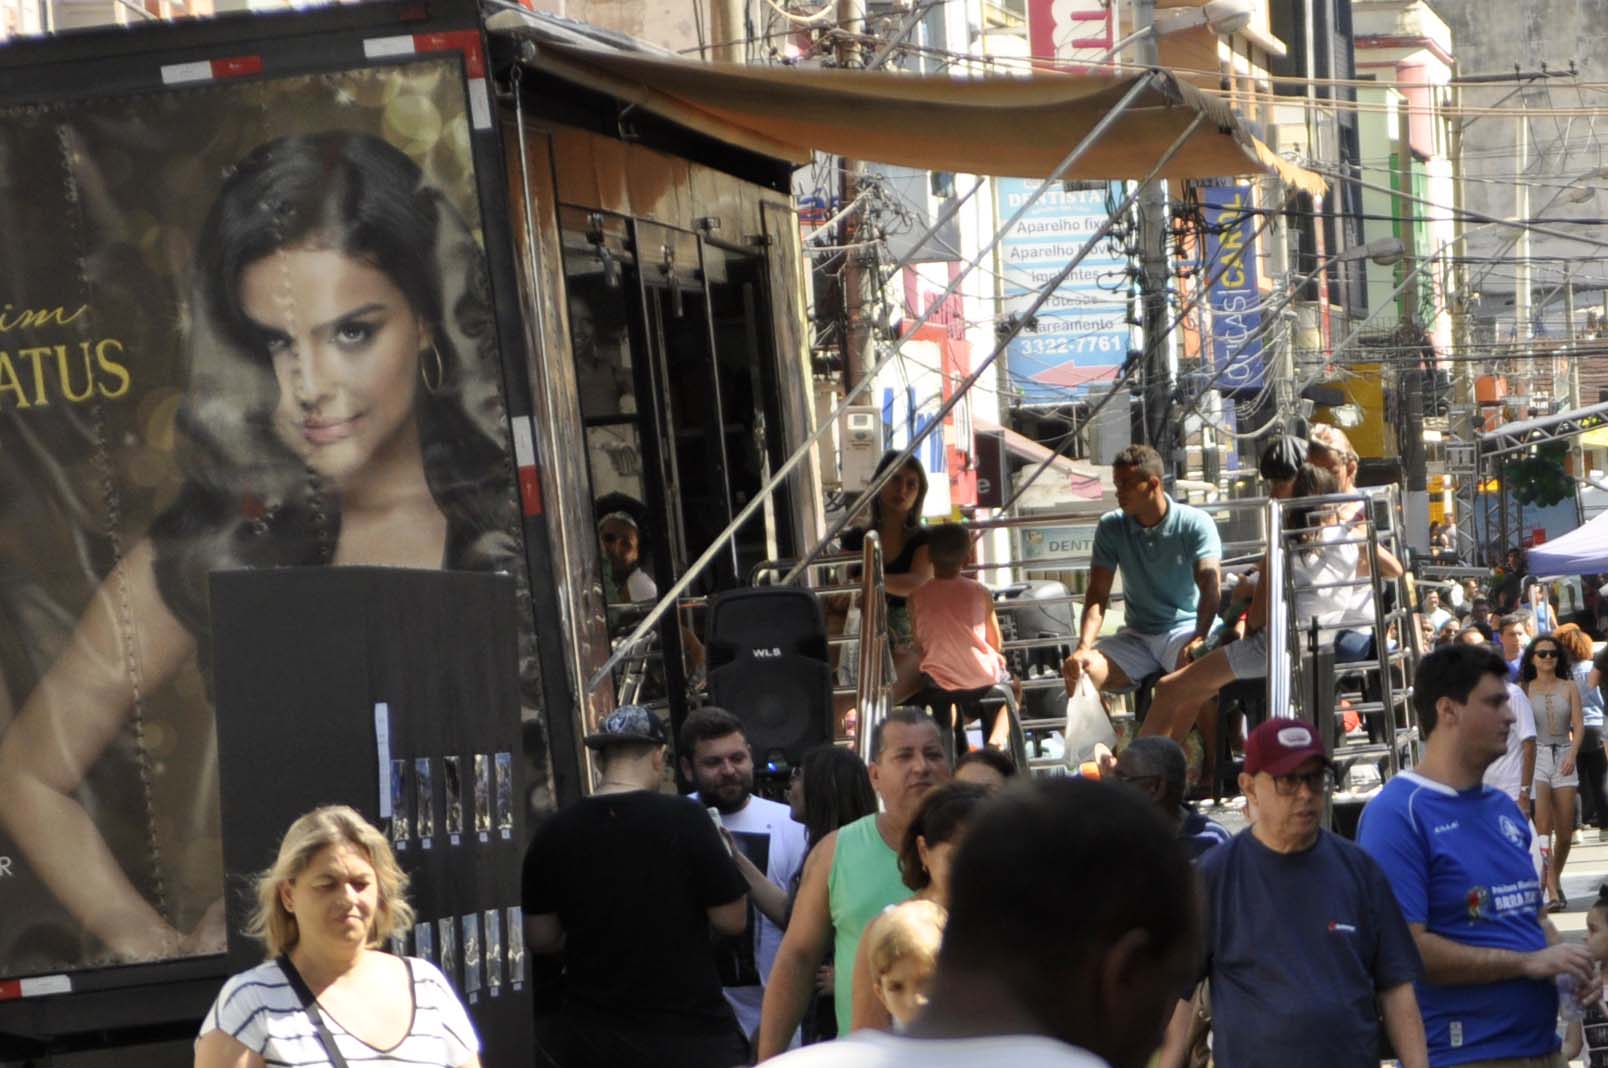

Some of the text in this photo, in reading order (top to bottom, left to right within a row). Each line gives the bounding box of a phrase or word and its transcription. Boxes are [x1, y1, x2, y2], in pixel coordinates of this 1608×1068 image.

[1016, 215, 1109, 235] Aparelho fix
[1217, 192, 1246, 289] CAROL
[1010, 242, 1075, 261] Aparelho
